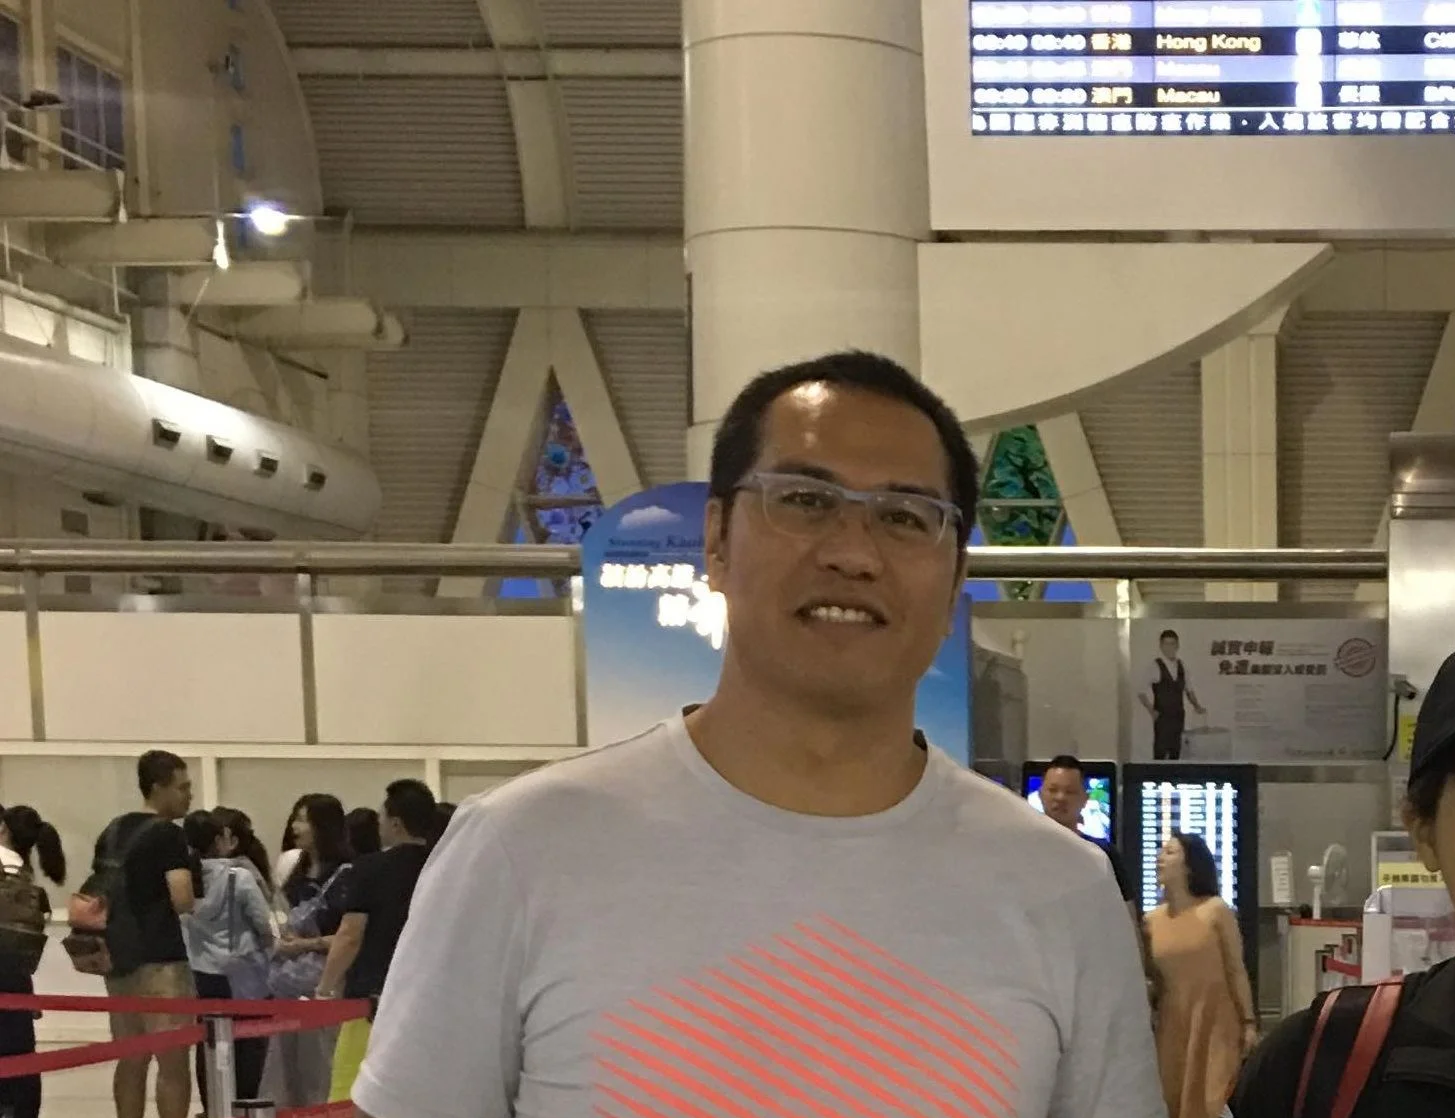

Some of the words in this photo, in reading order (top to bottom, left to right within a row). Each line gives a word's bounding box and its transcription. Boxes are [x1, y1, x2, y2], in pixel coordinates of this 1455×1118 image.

[1156, 34, 1207, 52] Hong
[1212, 34, 1262, 52] Kong
[1157, 88, 1221, 103] Macau
